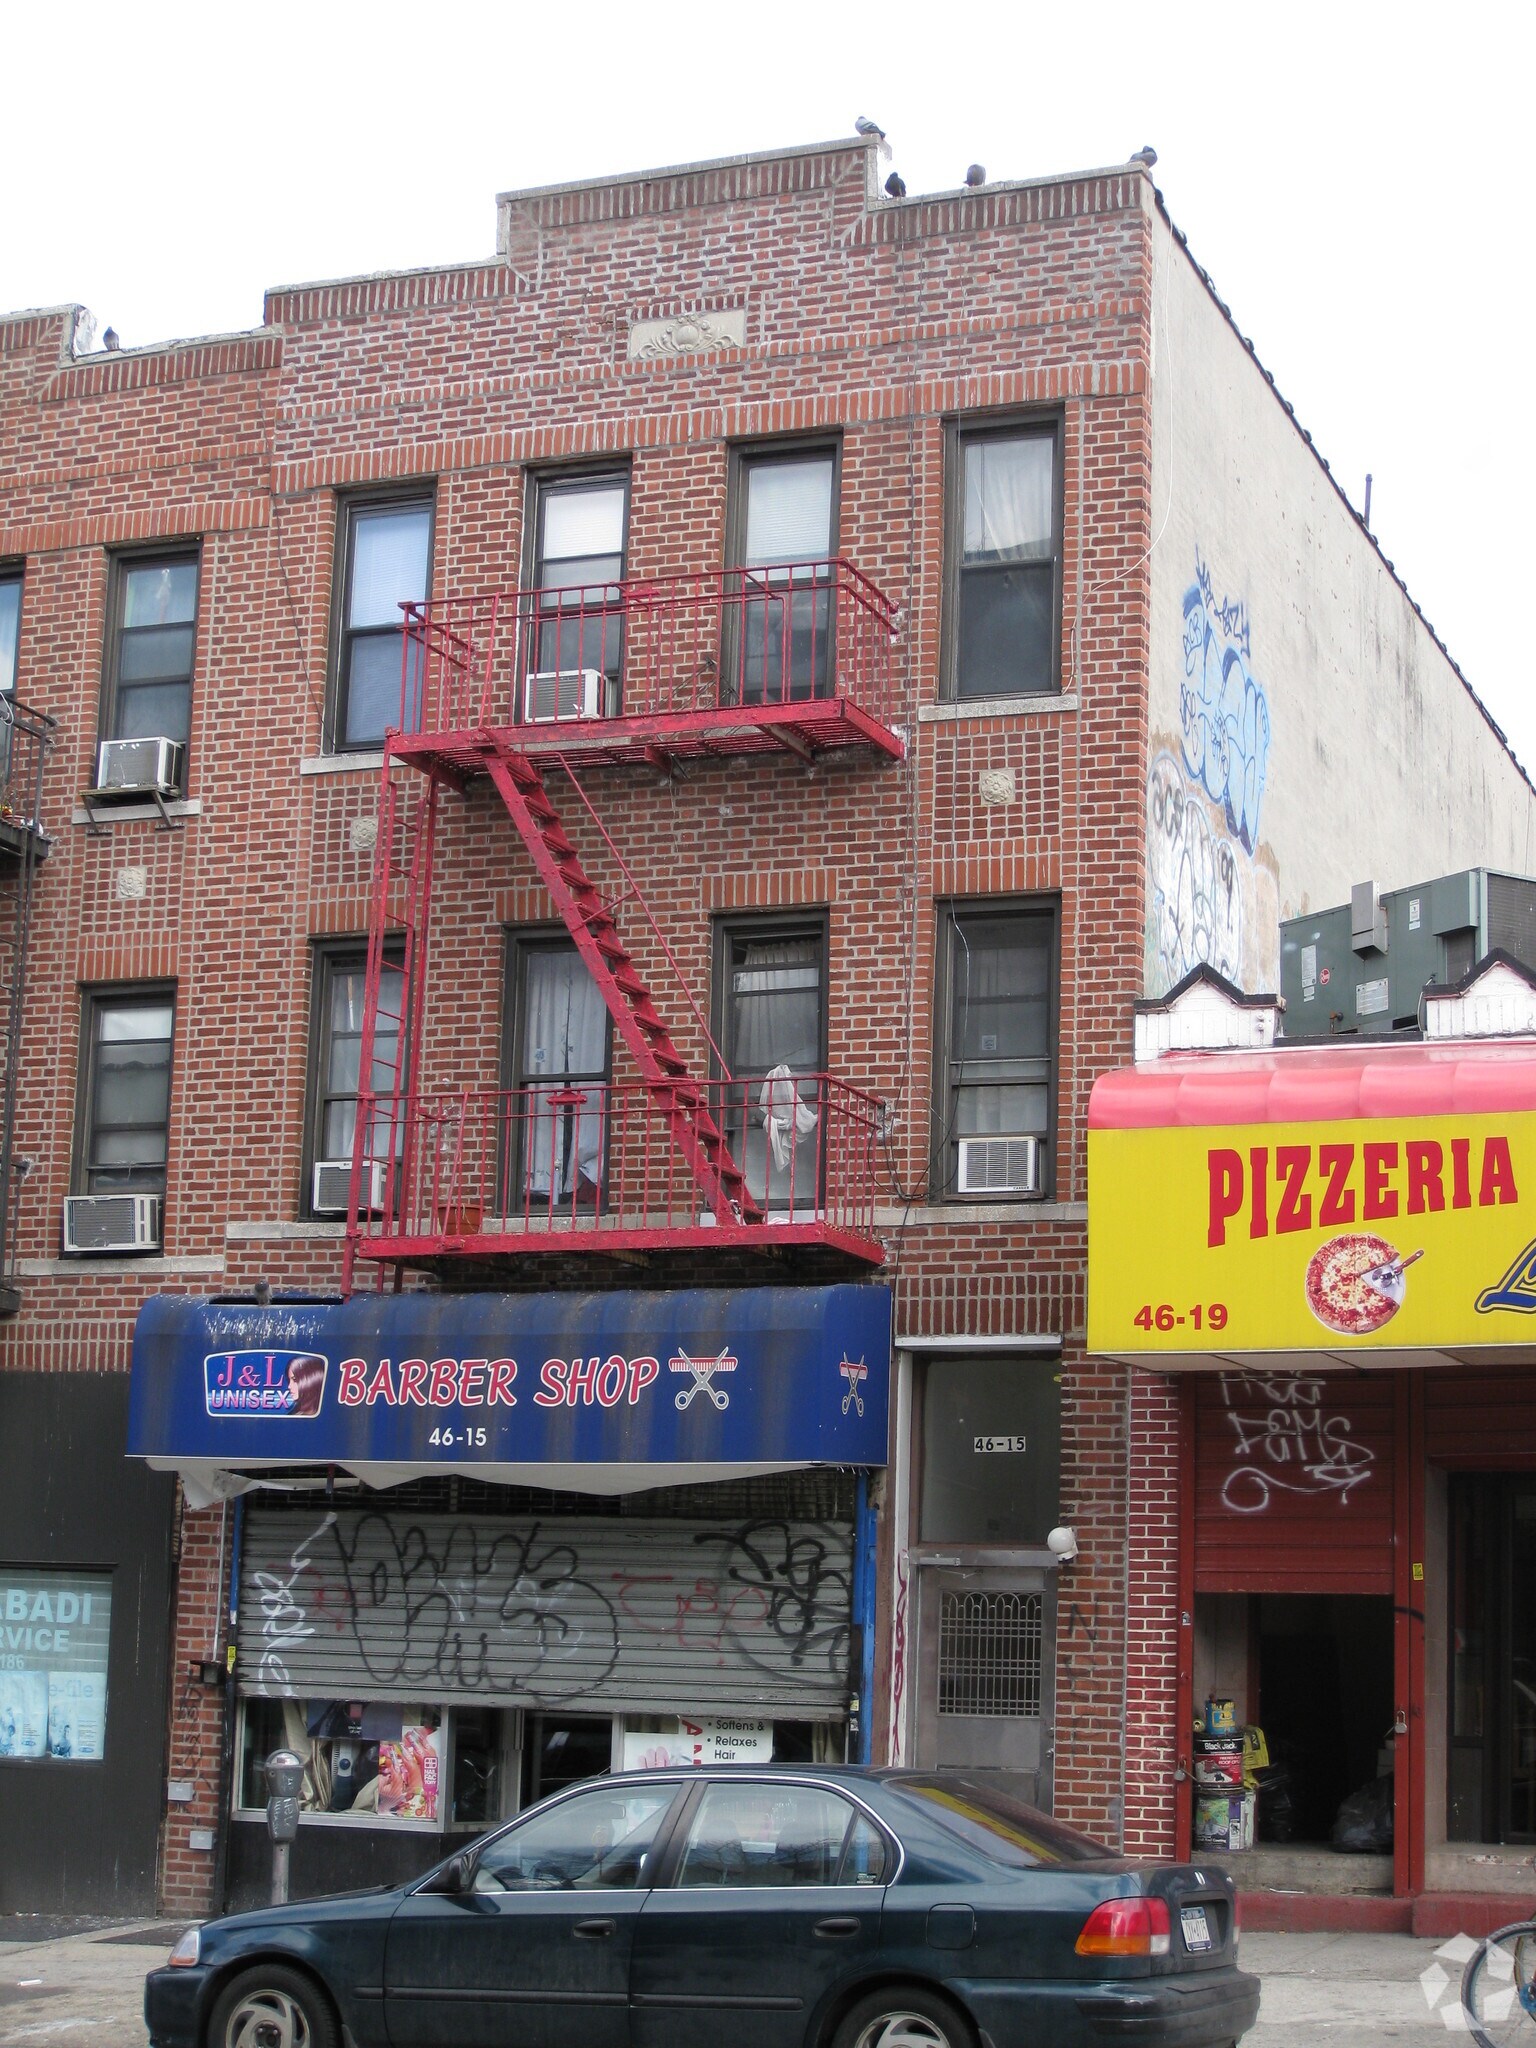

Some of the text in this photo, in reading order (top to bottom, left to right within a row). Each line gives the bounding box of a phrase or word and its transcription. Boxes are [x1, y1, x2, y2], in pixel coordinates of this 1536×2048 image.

[1207, 1136, 1519, 1248] PIZZERIA
[1133, 1303, 1228, 1331] 46-19
[337, 1355, 660, 1408] BARBER SHOP
[211, 1389, 291, 1409] UNISEX
[428, 1427, 487, 1446] 46-15
[975, 1437, 1025, 1451] 46-15
[0, 1588, 92, 1625] BADI
[716, 1719, 765, 1731] Softens &
[715, 1735, 758, 1747] Relaxes
[714, 1749, 736, 1760] Hair
